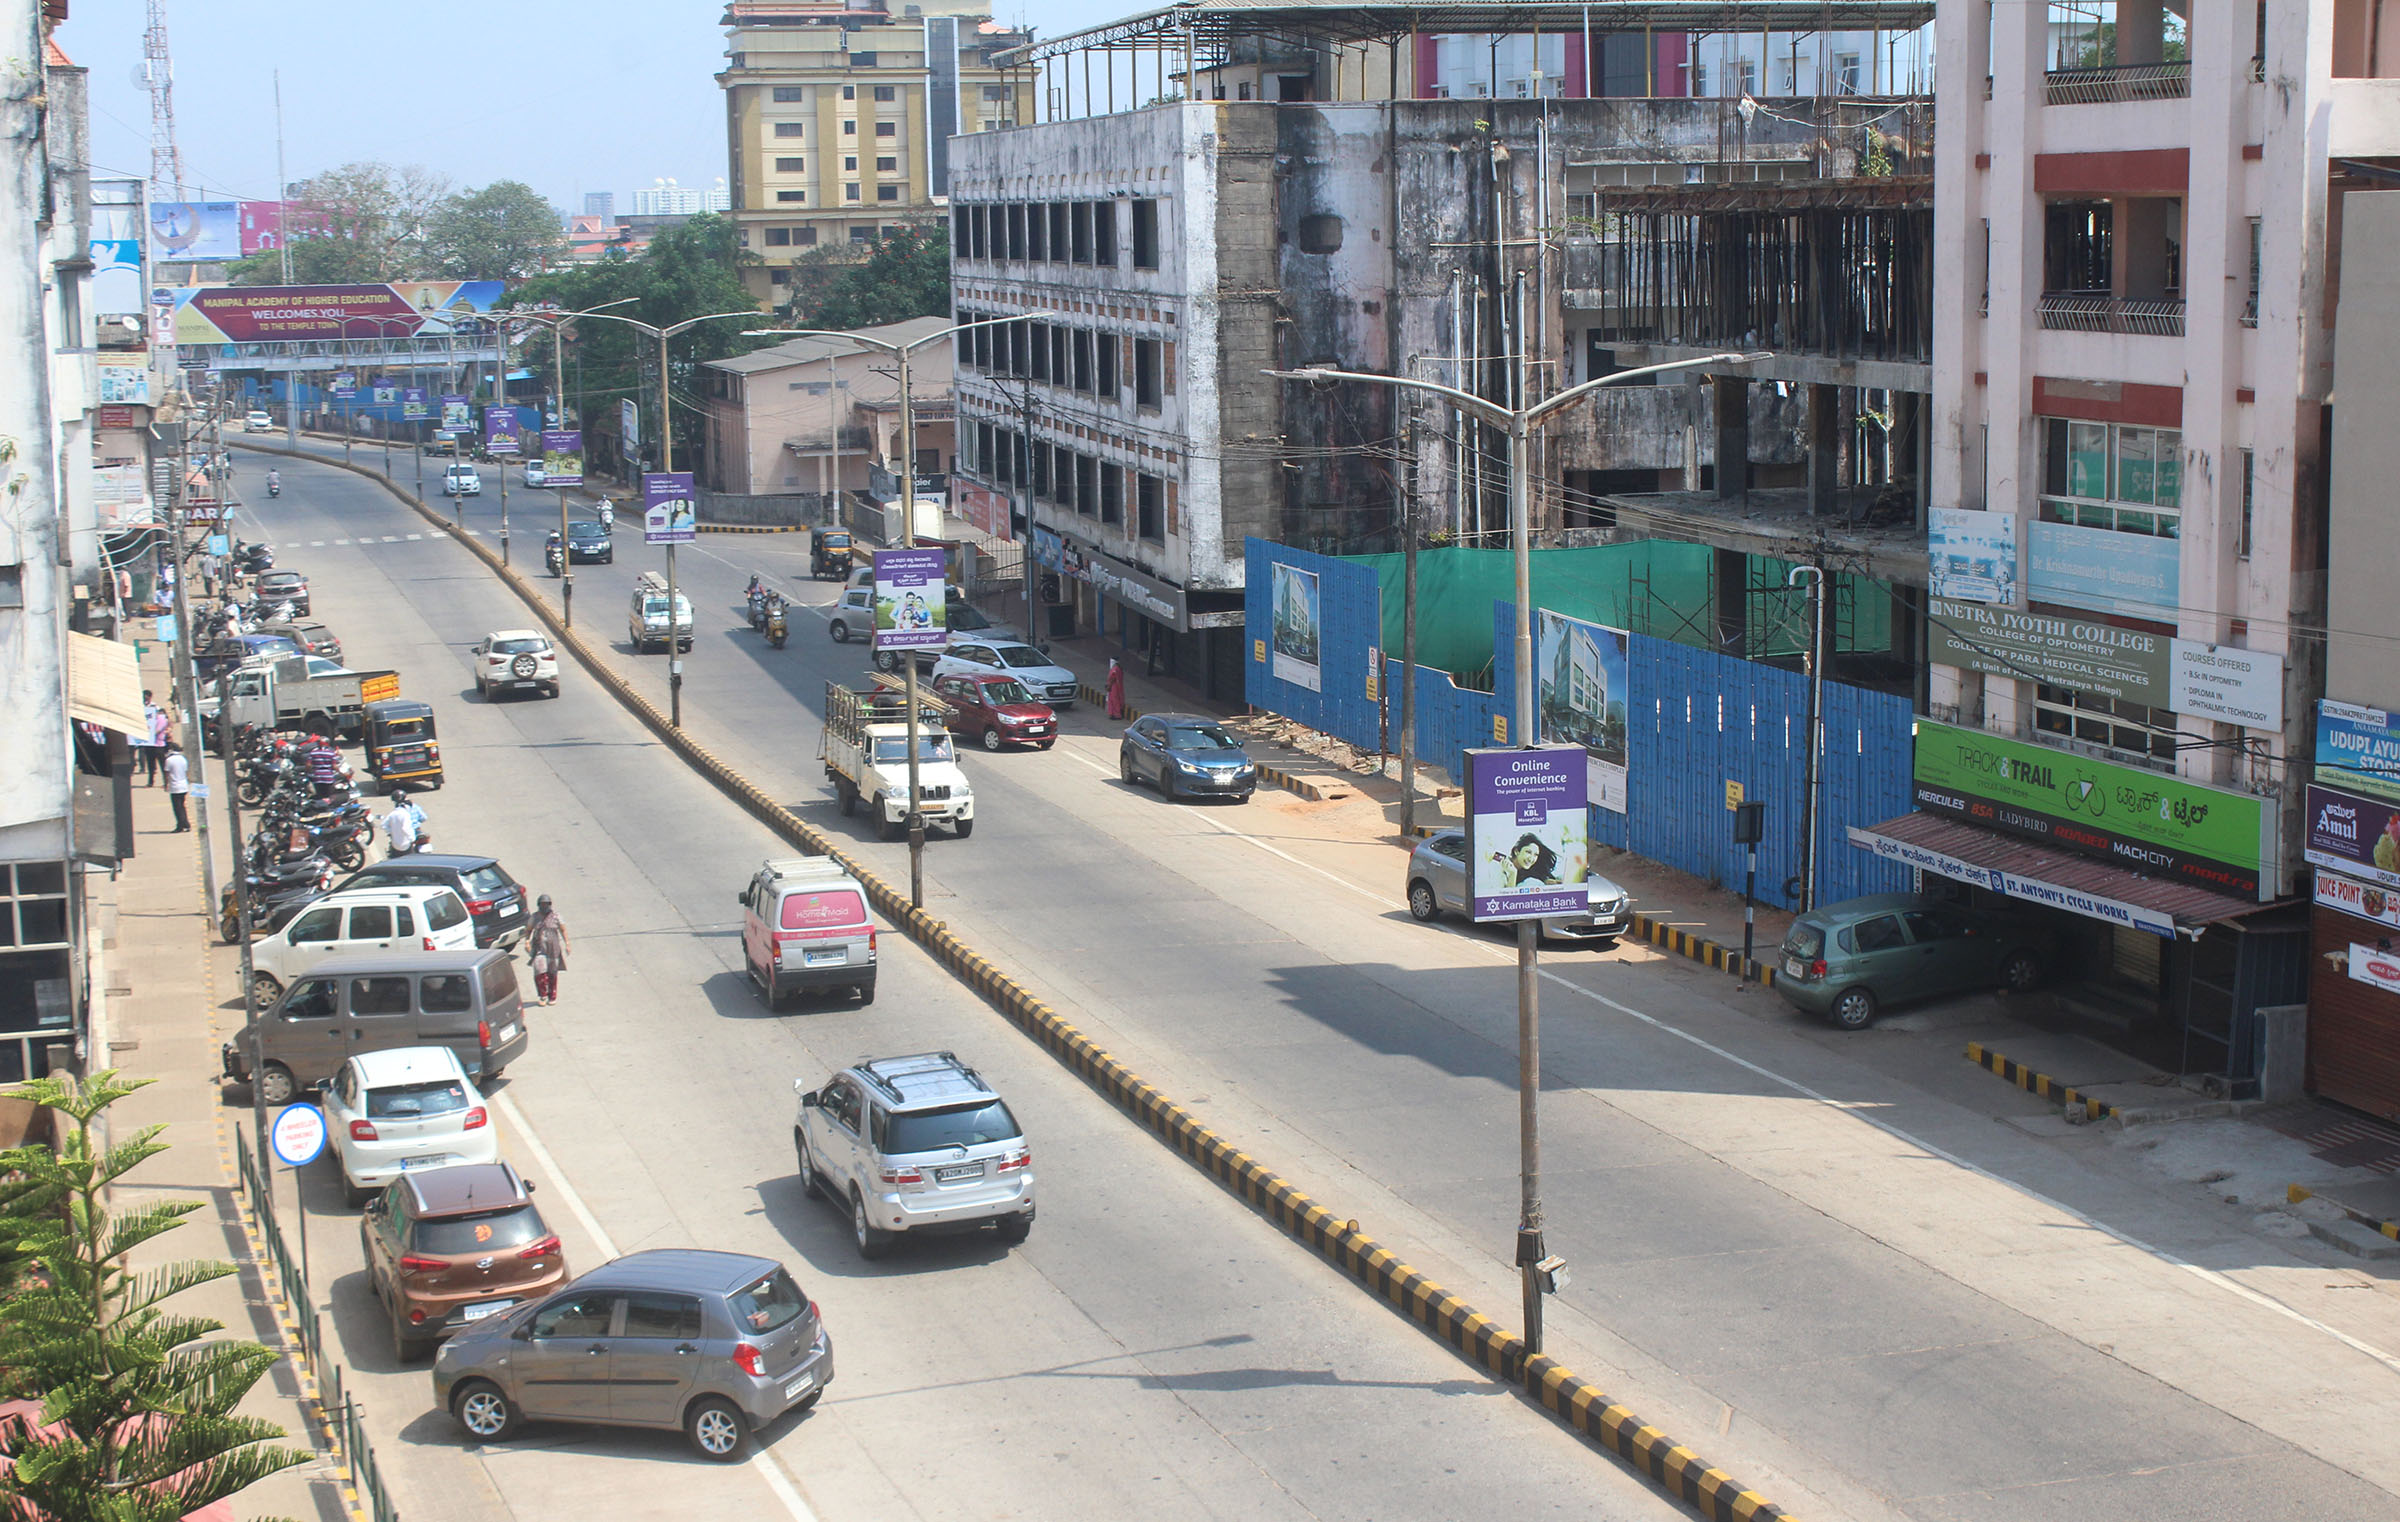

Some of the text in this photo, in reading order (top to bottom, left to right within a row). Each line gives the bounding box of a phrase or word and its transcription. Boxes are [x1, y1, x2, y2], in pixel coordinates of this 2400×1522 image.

[203, 294, 391, 307] MANIPAL ACADEMY OF HIGHER EDUCATION
[251, 308, 345, 319] WELCOMES YOU
[259, 320, 339, 330] TO THE TEMPLE TOWN
[1943, 603, 2155, 653] NETRA JYOTHI COLLEGE
[1980, 626, 2115, 656] COLLEGE OF OPTOMETRY
[1993, 649, 2008, 658] OF
[2010, 652, 2039, 664] PARA
[2043, 658, 2095, 674] MEDICAL
[2096, 668, 2150, 686] SCIENCES
[2183, 651, 2252, 673] COURSES OFFERED
[1982, 662, 2000, 673] Unit
[2002, 666, 2011, 675] of
[2047, 674, 2092, 690] Netralaya
[2094, 683, 2122, 697] Udupi)
[2208, 674, 2243, 688] OPTOMETRY
[2188, 686, 2215, 699] DIPLOMA
[2188, 699, 2268, 721] OPHTHALMIC TECHNOLOGY
[2329, 729, 2400, 762] UDUPI AYU
[1512, 760, 1550, 772] Online
[1957, 745, 2000, 777] TRACK
[2000, 757, 2010, 778] &
[2011, 759, 2056, 790] TRAIL
[1494, 773, 1567, 787] Convenience
[1918, 789, 1965, 810] HERCULES
[1971, 803, 1993, 818] BSA
[2159, 798, 2171, 821] &
[1999, 809, 2048, 833] LADYBIRD
[2317, 809, 2358, 841] Amul
[2182, 863, 2255, 891] montra
[2006, 878, 2129, 921] ST. ANTONY'S CYCLE WORKS
[2317, 876, 2360, 904] JUICE POINT
[796, 910, 820, 919] Home
[1502, 897, 1577, 911] Karnataka Bank
